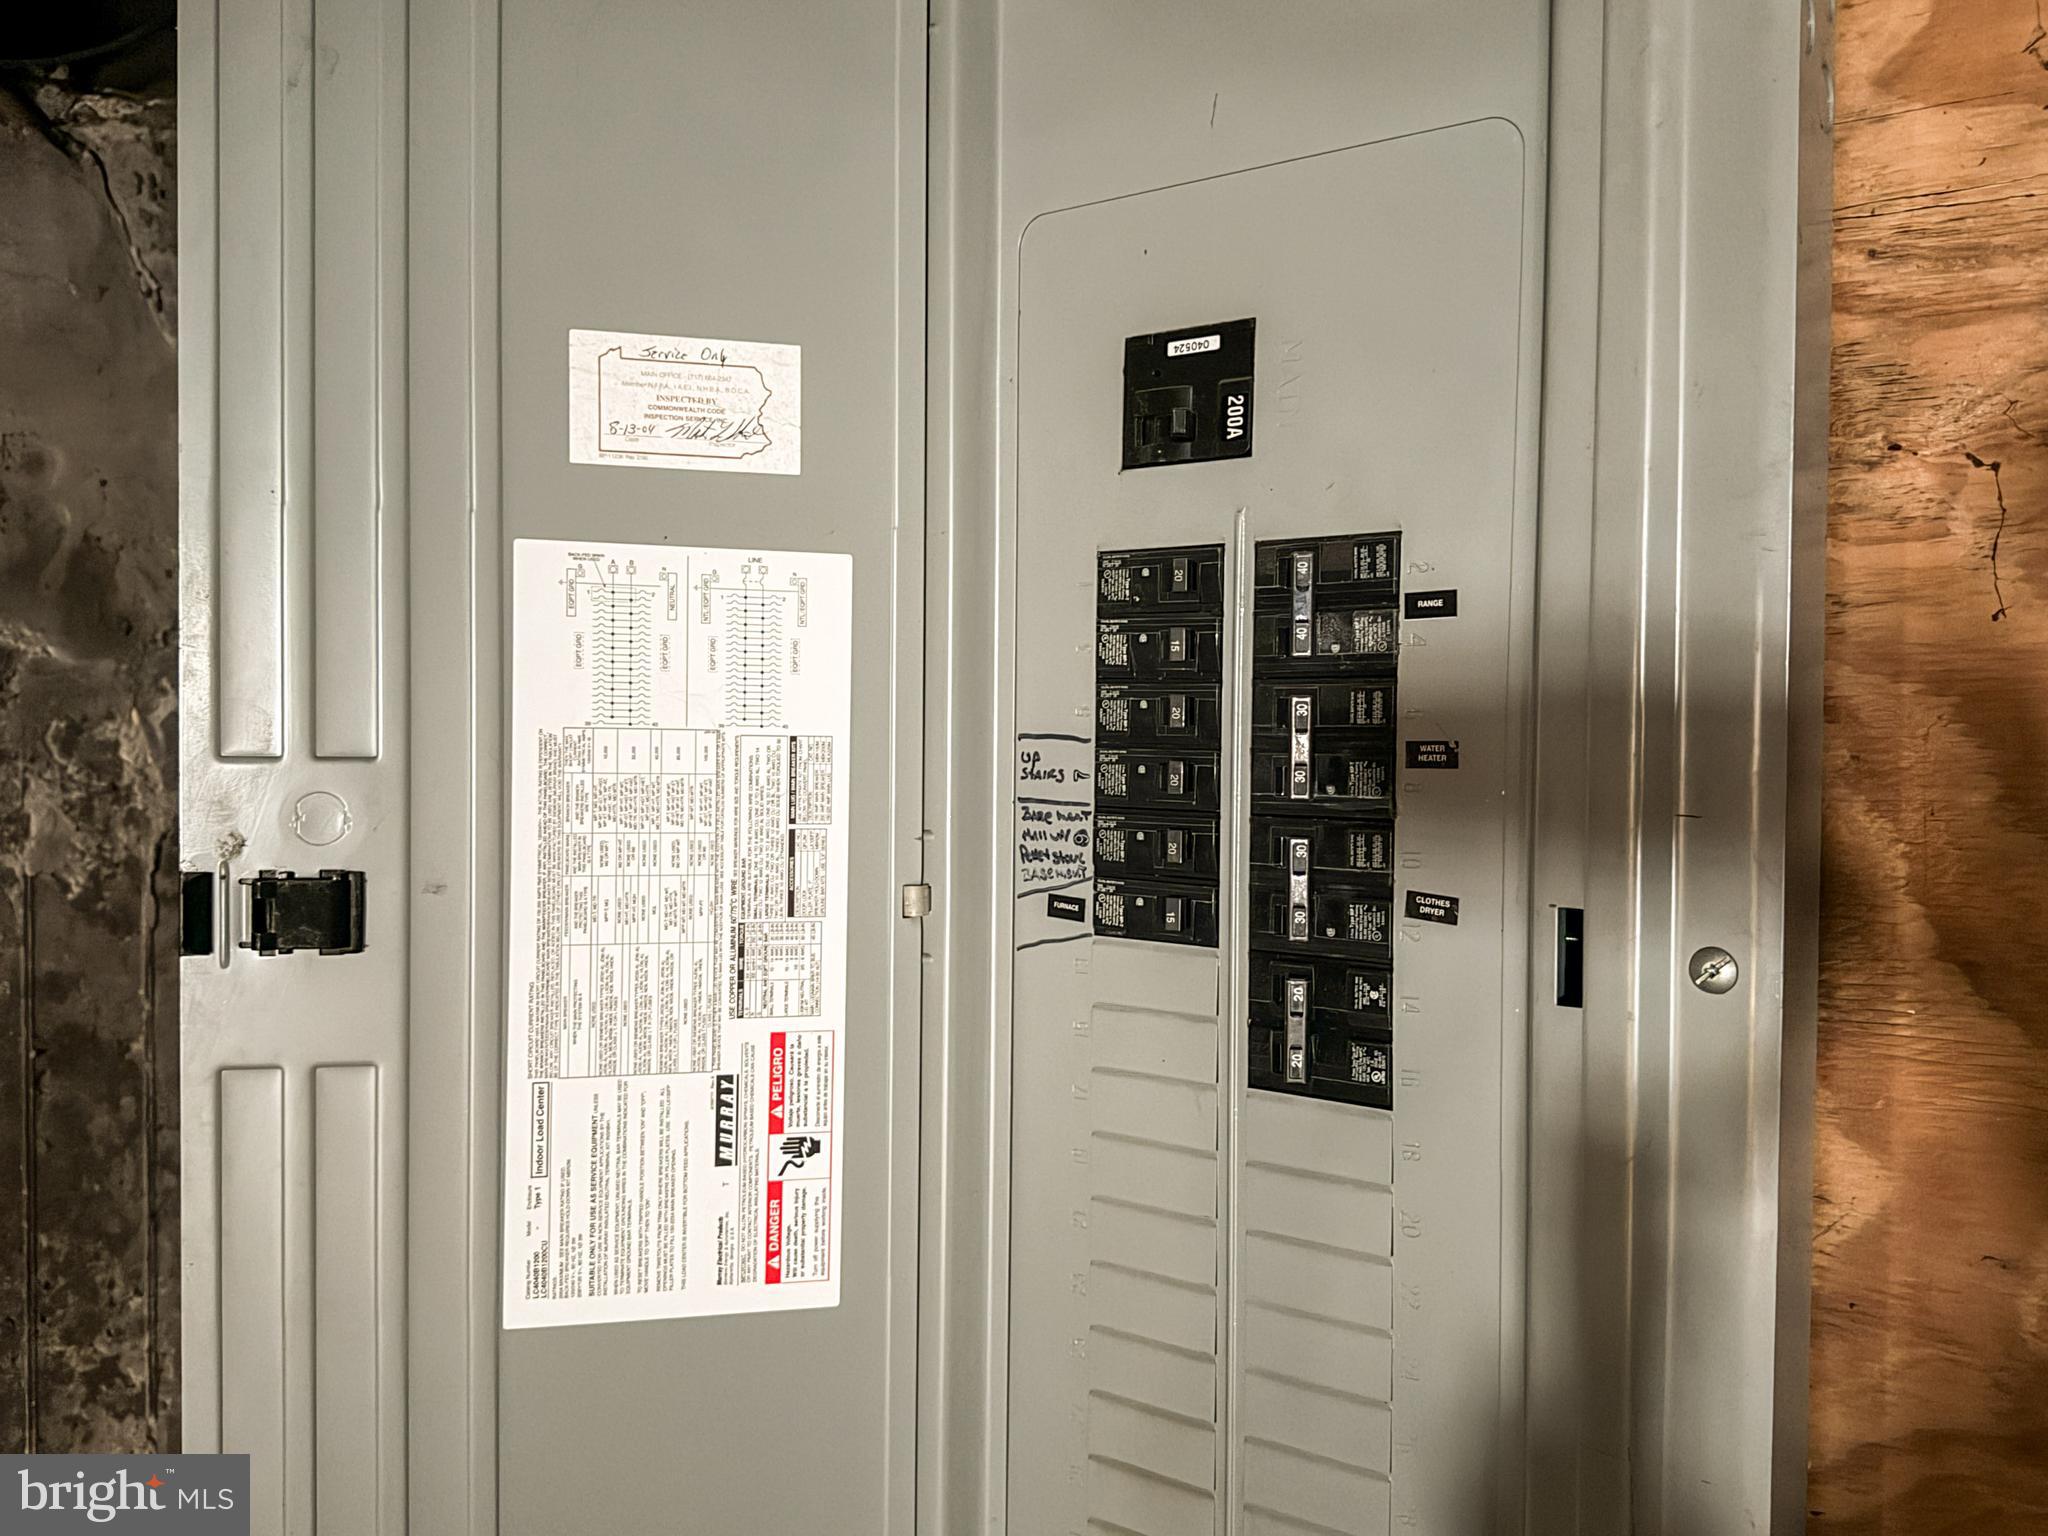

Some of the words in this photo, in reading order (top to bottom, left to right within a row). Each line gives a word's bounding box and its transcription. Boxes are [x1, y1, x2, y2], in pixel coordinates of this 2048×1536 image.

[639, 345, 688, 359] Service
[1173, 339, 1210, 354] 040524
[648, 404, 705, 413] COMMONWEALTH
[644, 413, 684, 421] INSPECTION
[1226, 395, 1245, 440] 200A
[1297, 561, 1308, 575] 40
[1174, 569, 1184, 582] 20
[1418, 599, 1443, 608] RANGE
[1296, 627, 1308, 640] 40
[1170, 640, 1180, 652] 15
[1171, 707, 1181, 720] 20
[1296, 703, 1308, 717] 30
[1418, 754, 1447, 762] HEATER
[1170, 774, 1179, 786] 20
[1294, 770, 1306, 783] 30
[1168, 842, 1177, 855] 20
[1296, 844, 1307, 858] 30
[1053, 901, 1080, 912] FURNACE
[1416, 895, 1450, 908] CLOTHES
[1166, 911, 1175, 923] 15
[1294, 911, 1306, 924] 30
[1419, 906, 1445, 917] DRYER
[729, 963, 736, 974] OR
[1294, 987, 1304, 1002] 20
[1292, 1053, 1302, 1068] 20
[772, 1047, 783, 1101] PELIGRO
[536, 1086, 545, 1116] Center
[719, 1079, 733, 1160] MURRAY
[535, 1119, 544, 1142] Load
[535, 1145, 544, 1174] Indoor
[534, 1192, 542, 1209] Type
[590, 1193, 596, 1204] AS
[769, 1199, 780, 1252] DANGER
